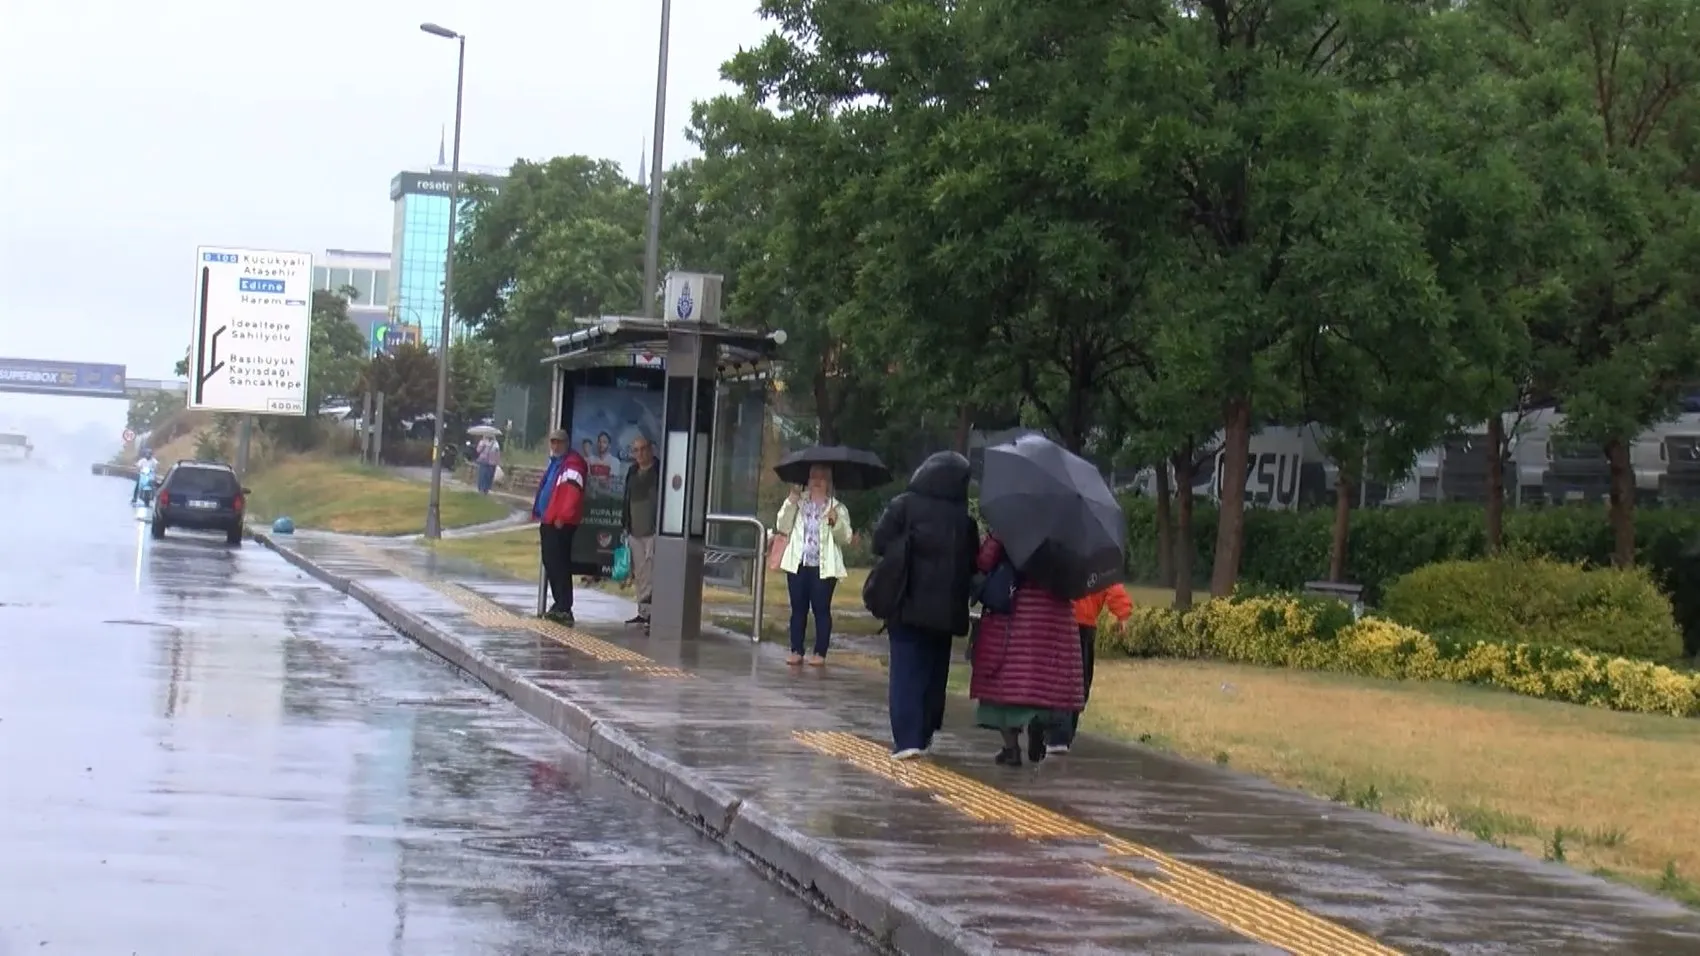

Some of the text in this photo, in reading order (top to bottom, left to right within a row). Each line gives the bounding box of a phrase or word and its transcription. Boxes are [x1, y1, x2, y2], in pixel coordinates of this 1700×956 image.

[241, 280, 283, 291] Edirne
[241, 295, 282, 304] Harem
[231, 330, 291, 343] Sahilyolu
[229, 376, 301, 390] Sancaktepe
